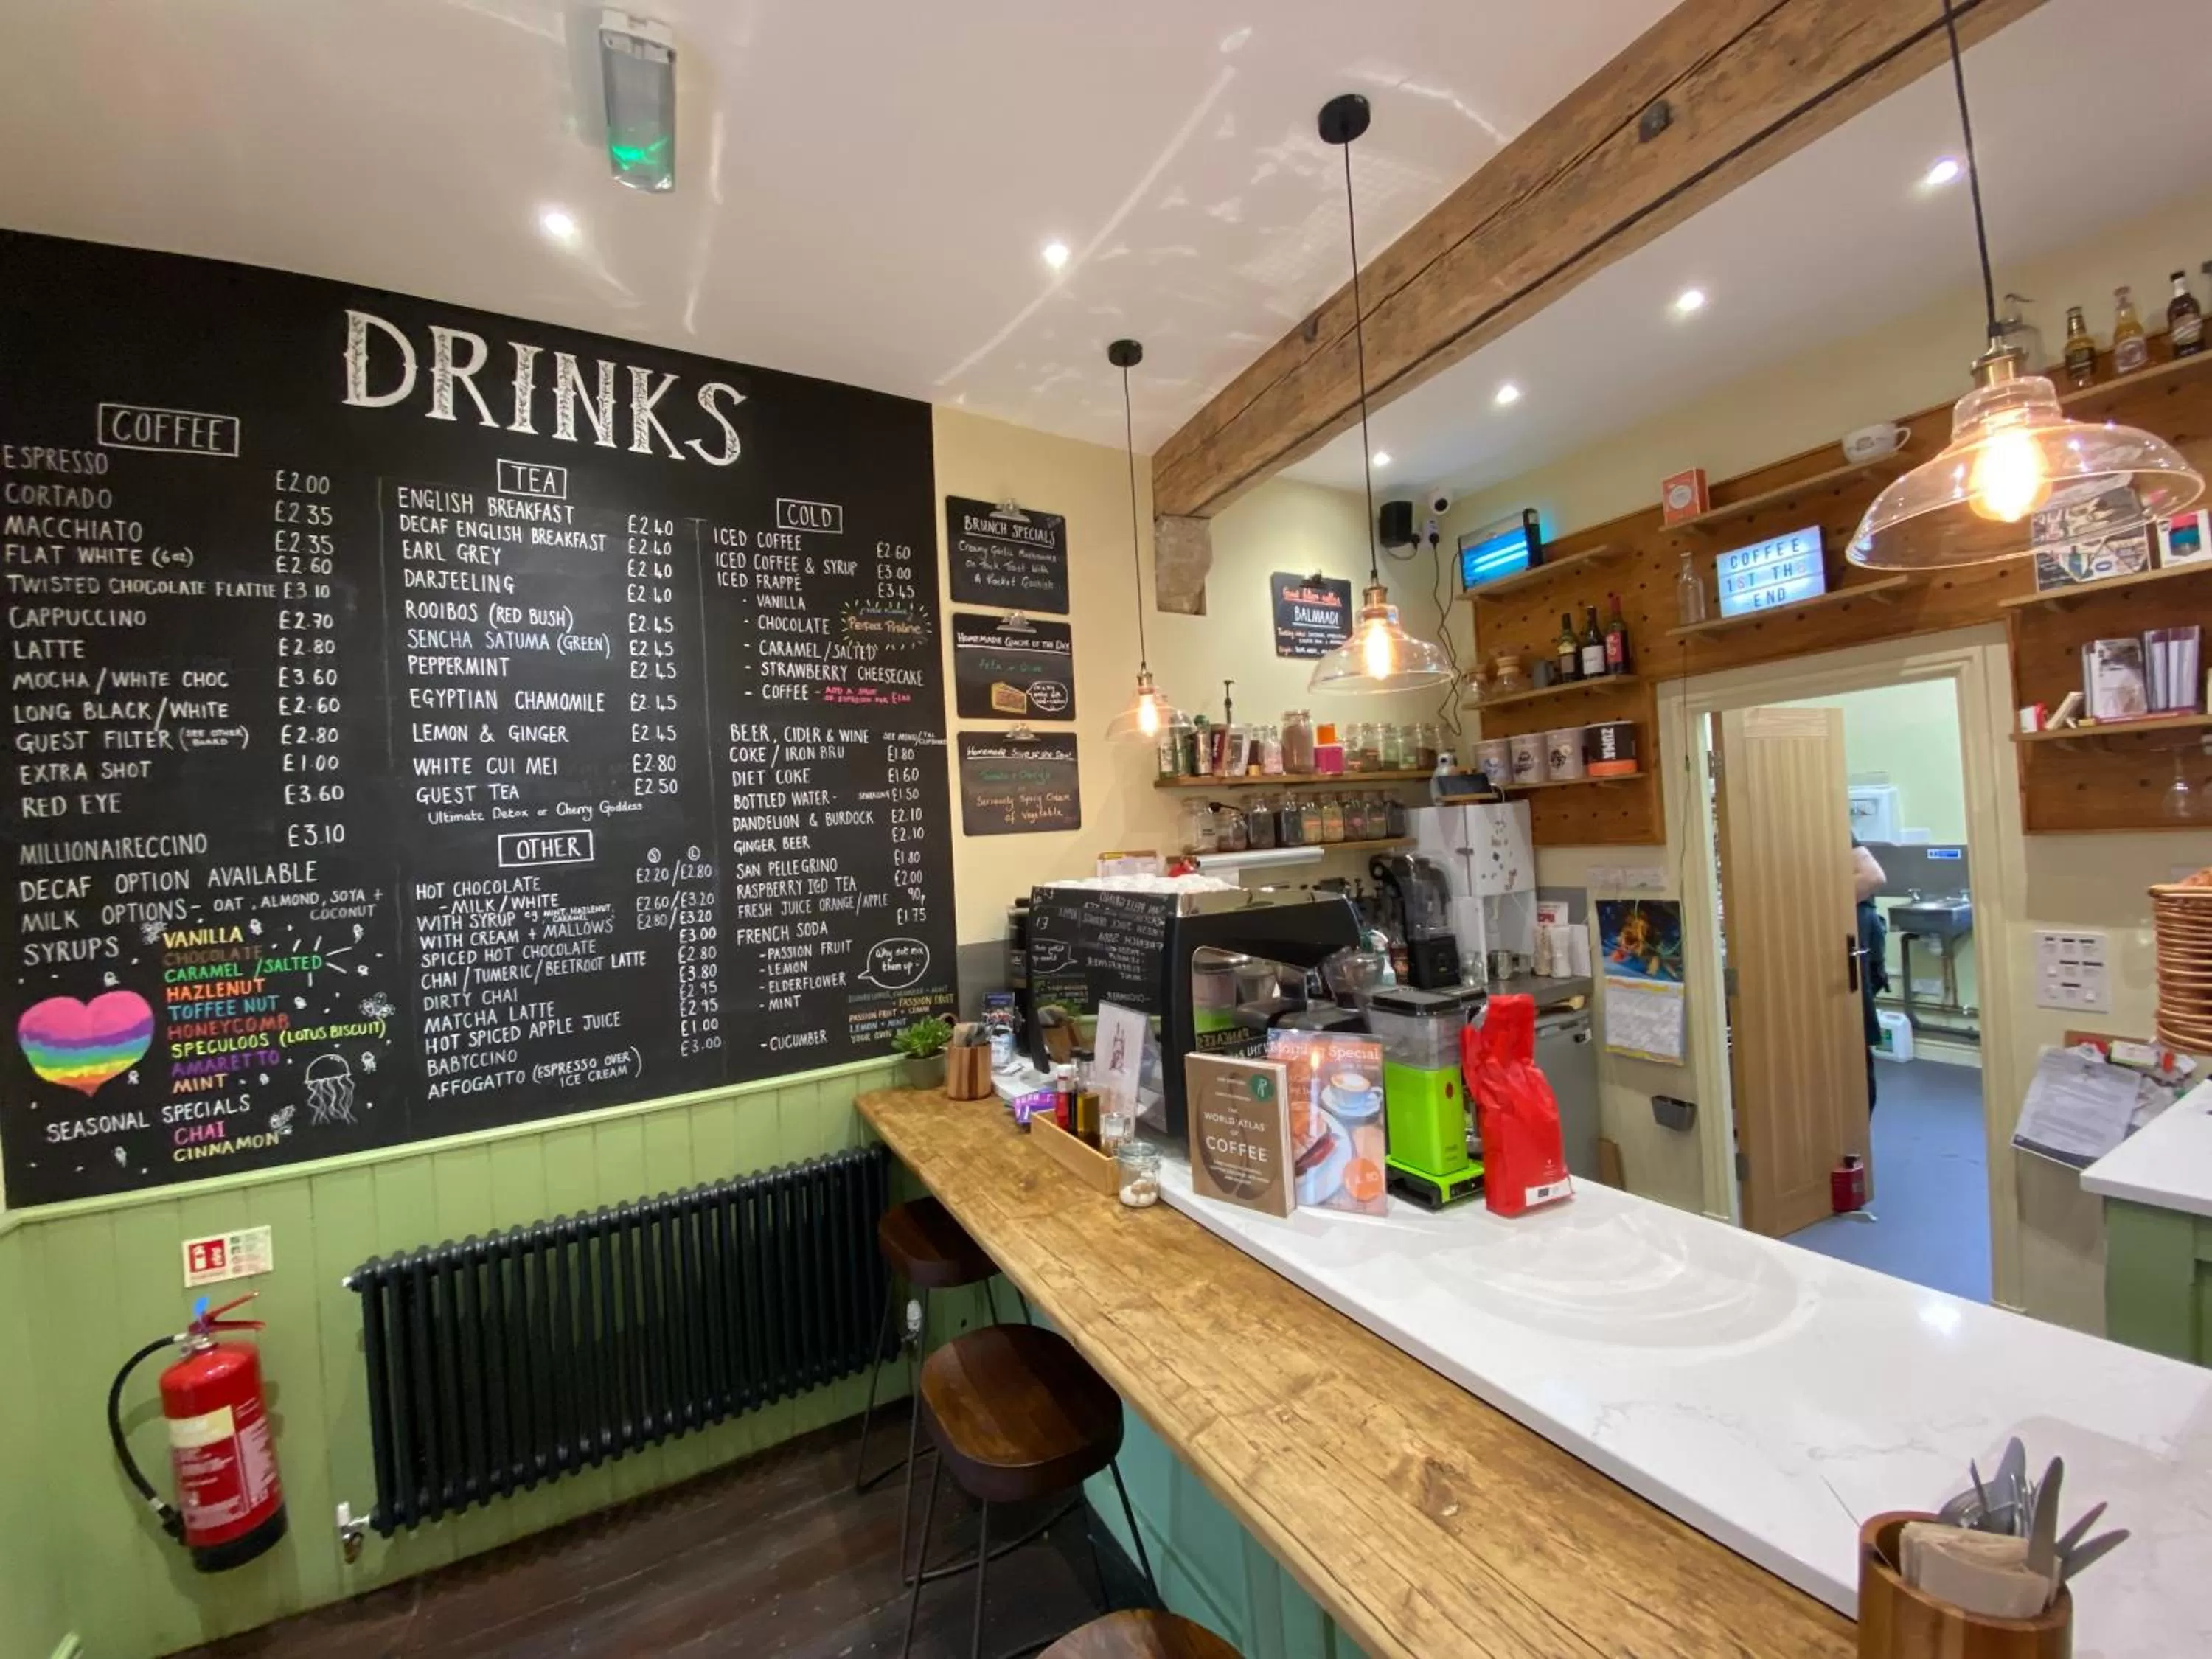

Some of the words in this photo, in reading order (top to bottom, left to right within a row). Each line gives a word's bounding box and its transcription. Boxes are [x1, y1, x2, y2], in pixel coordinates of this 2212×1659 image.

[342, 309, 747, 467] DRINKS
[112, 411, 224, 451] COFFEE
[3, 445, 108, 476] ESPRESSO
[511, 465, 556, 493] TEA
[5, 483, 113, 509] CORTADO
[397, 487, 473, 514] ENGLISH
[487, 495, 574, 525] BREAKFAST
[787, 504, 832, 528] COLD
[964, 515, 1008, 535] BRUNCH
[4, 515, 142, 543] MACCHIATO
[713, 526, 748, 547] ICED
[757, 532, 802, 551] COFFEE
[5, 545, 65, 565] FLAT
[78, 548, 142, 566] WHITE
[402, 540, 446, 561] EARL
[457, 543, 501, 566] GREY
[754, 553, 799, 572] COFFEE
[1730, 538, 1800, 570] COFFEE
[7, 574, 100, 594] TWISTED
[108, 577, 206, 597] CHOCOLATE
[403, 569, 515, 595] DARJEELING
[1754, 588, 1786, 608] END
[10, 608, 146, 629] CAPPUCCINO
[405, 599, 479, 622] ROOIBOS
[14, 639, 86, 660] LATTE
[407, 629, 473, 650] SENCHA
[485, 633, 549, 651] SATUMA
[557, 633, 611, 660] (GREEN)
[408, 655, 510, 677] PEPPERMINT
[760, 661, 847, 682] STRAWBERRY
[858, 666, 924, 687] CHEESECAKE
[183, 672, 229, 687] CHOC
[409, 688, 498, 711] EGYPTIAN
[515, 691, 605, 712] CHAMOMILE
[762, 684, 809, 700] COFFEE
[14, 703, 72, 724] LONG
[15, 731, 89, 753] GUEST
[105, 731, 173, 751] FILTER
[412, 723, 468, 742] LEMON
[480, 725, 495, 742] &
[509, 725, 568, 743] GINGER
[784, 726, 821, 742] CIDER
[839, 728, 870, 744] WINE
[729, 746, 767, 763] COKE
[785, 745, 815, 761] IRON
[820, 745, 844, 759] BRU
[20, 764, 87, 785] EXTRA
[102, 761, 152, 779] SHOT
[486, 757, 515, 776] CUI
[526, 757, 558, 776] MEI
[732, 770, 765, 787] DIET
[22, 796, 66, 818] RED
[81, 793, 122, 814] EYE
[428, 809, 484, 824] Ultimate
[493, 806, 529, 820] Detox
[557, 801, 592, 821] Cherry
[599, 800, 643, 816] Goddess
[734, 792, 785, 810] BOTTLED
[732, 814, 800, 832] DANDELION
[825, 810, 874, 827] BURDOCK
[19, 833, 207, 865] MILLIONAIRECCINO
[517, 836, 581, 860] OTHER
[783, 835, 811, 851] BEER
[737, 863, 761, 880] SAN
[768, 858, 838, 877] PELLEGRINO
[20, 876, 92, 902] DECAF
[116, 870, 189, 894] OPTION
[208, 861, 317, 888] AVAILABLE
[416, 882, 445, 900] HOT
[737, 880, 802, 900] RASPBERRY
[21, 910, 79, 933] MILK
[213, 897, 243, 912] OAT
[330, 889, 365, 903] SOYA
[310, 905, 375, 921] COCONUT
[417, 914, 462, 932] WITH
[469, 911, 515, 929] SYRUP
[738, 903, 773, 920] FRESH
[470, 930, 519, 946] CREAM
[543, 919, 613, 939] MALLOWS
[737, 925, 790, 947] FRENCH
[796, 920, 829, 938] SODA
[23, 936, 119, 967] SYRUPS
[162, 925, 244, 950] VANILLA
[821, 939, 852, 955] FRUIT
[421, 950, 477, 968] SPICED
[164, 964, 243, 984] CARAMEL
[165, 979, 265, 1003] HAZLENUT
[423, 991, 471, 1011] DIRTY
[167, 1000, 237, 1022] TOFFEE
[244, 995, 279, 1013] NUT
[167, 1013, 291, 1041] HONEYCOMB
[424, 1011, 498, 1034] MATCHA
[529, 1018, 573, 1039] APPLE
[583, 1012, 622, 1030] JUICE
[170, 1033, 269, 1059] SPECULOOS
[426, 1050, 518, 1077] BABYCCINO
[173, 1074, 228, 1094] MINT
[428, 1070, 526, 1100] AFFOGATTO
[559, 1075, 582, 1088] ICE
[46, 1110, 150, 1144] SEASONAL
[161, 1093, 251, 1123] SPECIALS
[1203, 1111, 1235, 1125] WORLD
[1238, 1119, 1266, 1132] ATLAS
[173, 1121, 226, 1145] CHAI
[173, 1132, 279, 1163] CINNAMON
[1206, 1135, 1268, 1163] COFFEE
